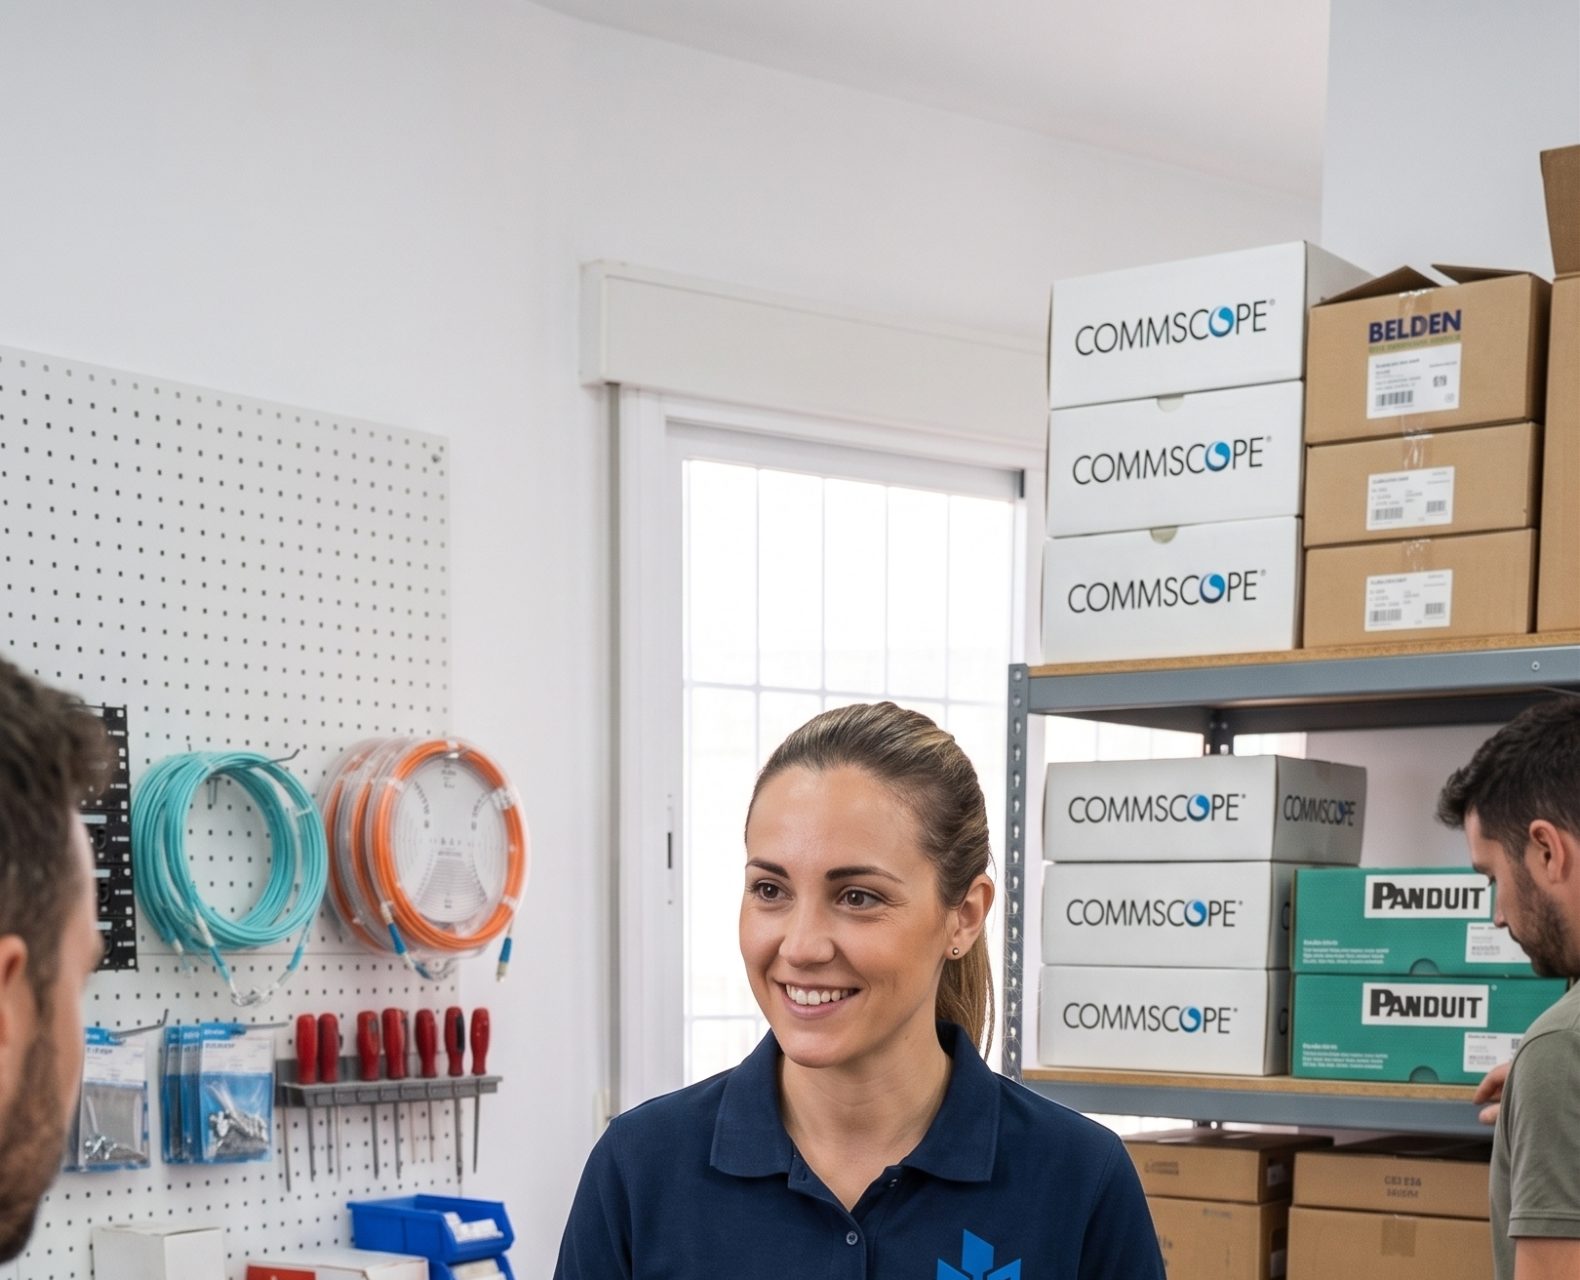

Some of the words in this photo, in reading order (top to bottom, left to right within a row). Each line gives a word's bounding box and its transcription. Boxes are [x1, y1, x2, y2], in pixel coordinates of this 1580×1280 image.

[1075, 299, 1268, 356] COMMSCOPE
[1368, 309, 1462, 343] BELDEN
[1072, 436, 1264, 485] COMMSCOPE
[1067, 569, 1258, 613] COMMSCOPE
[1068, 792, 1239, 824] COMMSCOPE
[1283, 794, 1356, 827] COMMSCOPE
[1371, 881, 1486, 911] PANDUIT
[1066, 898, 1237, 928] COMMSCOPE
[1063, 1002, 1231, 1035] COMMSCOPE
[1369, 988, 1484, 1019] PANDUIT
